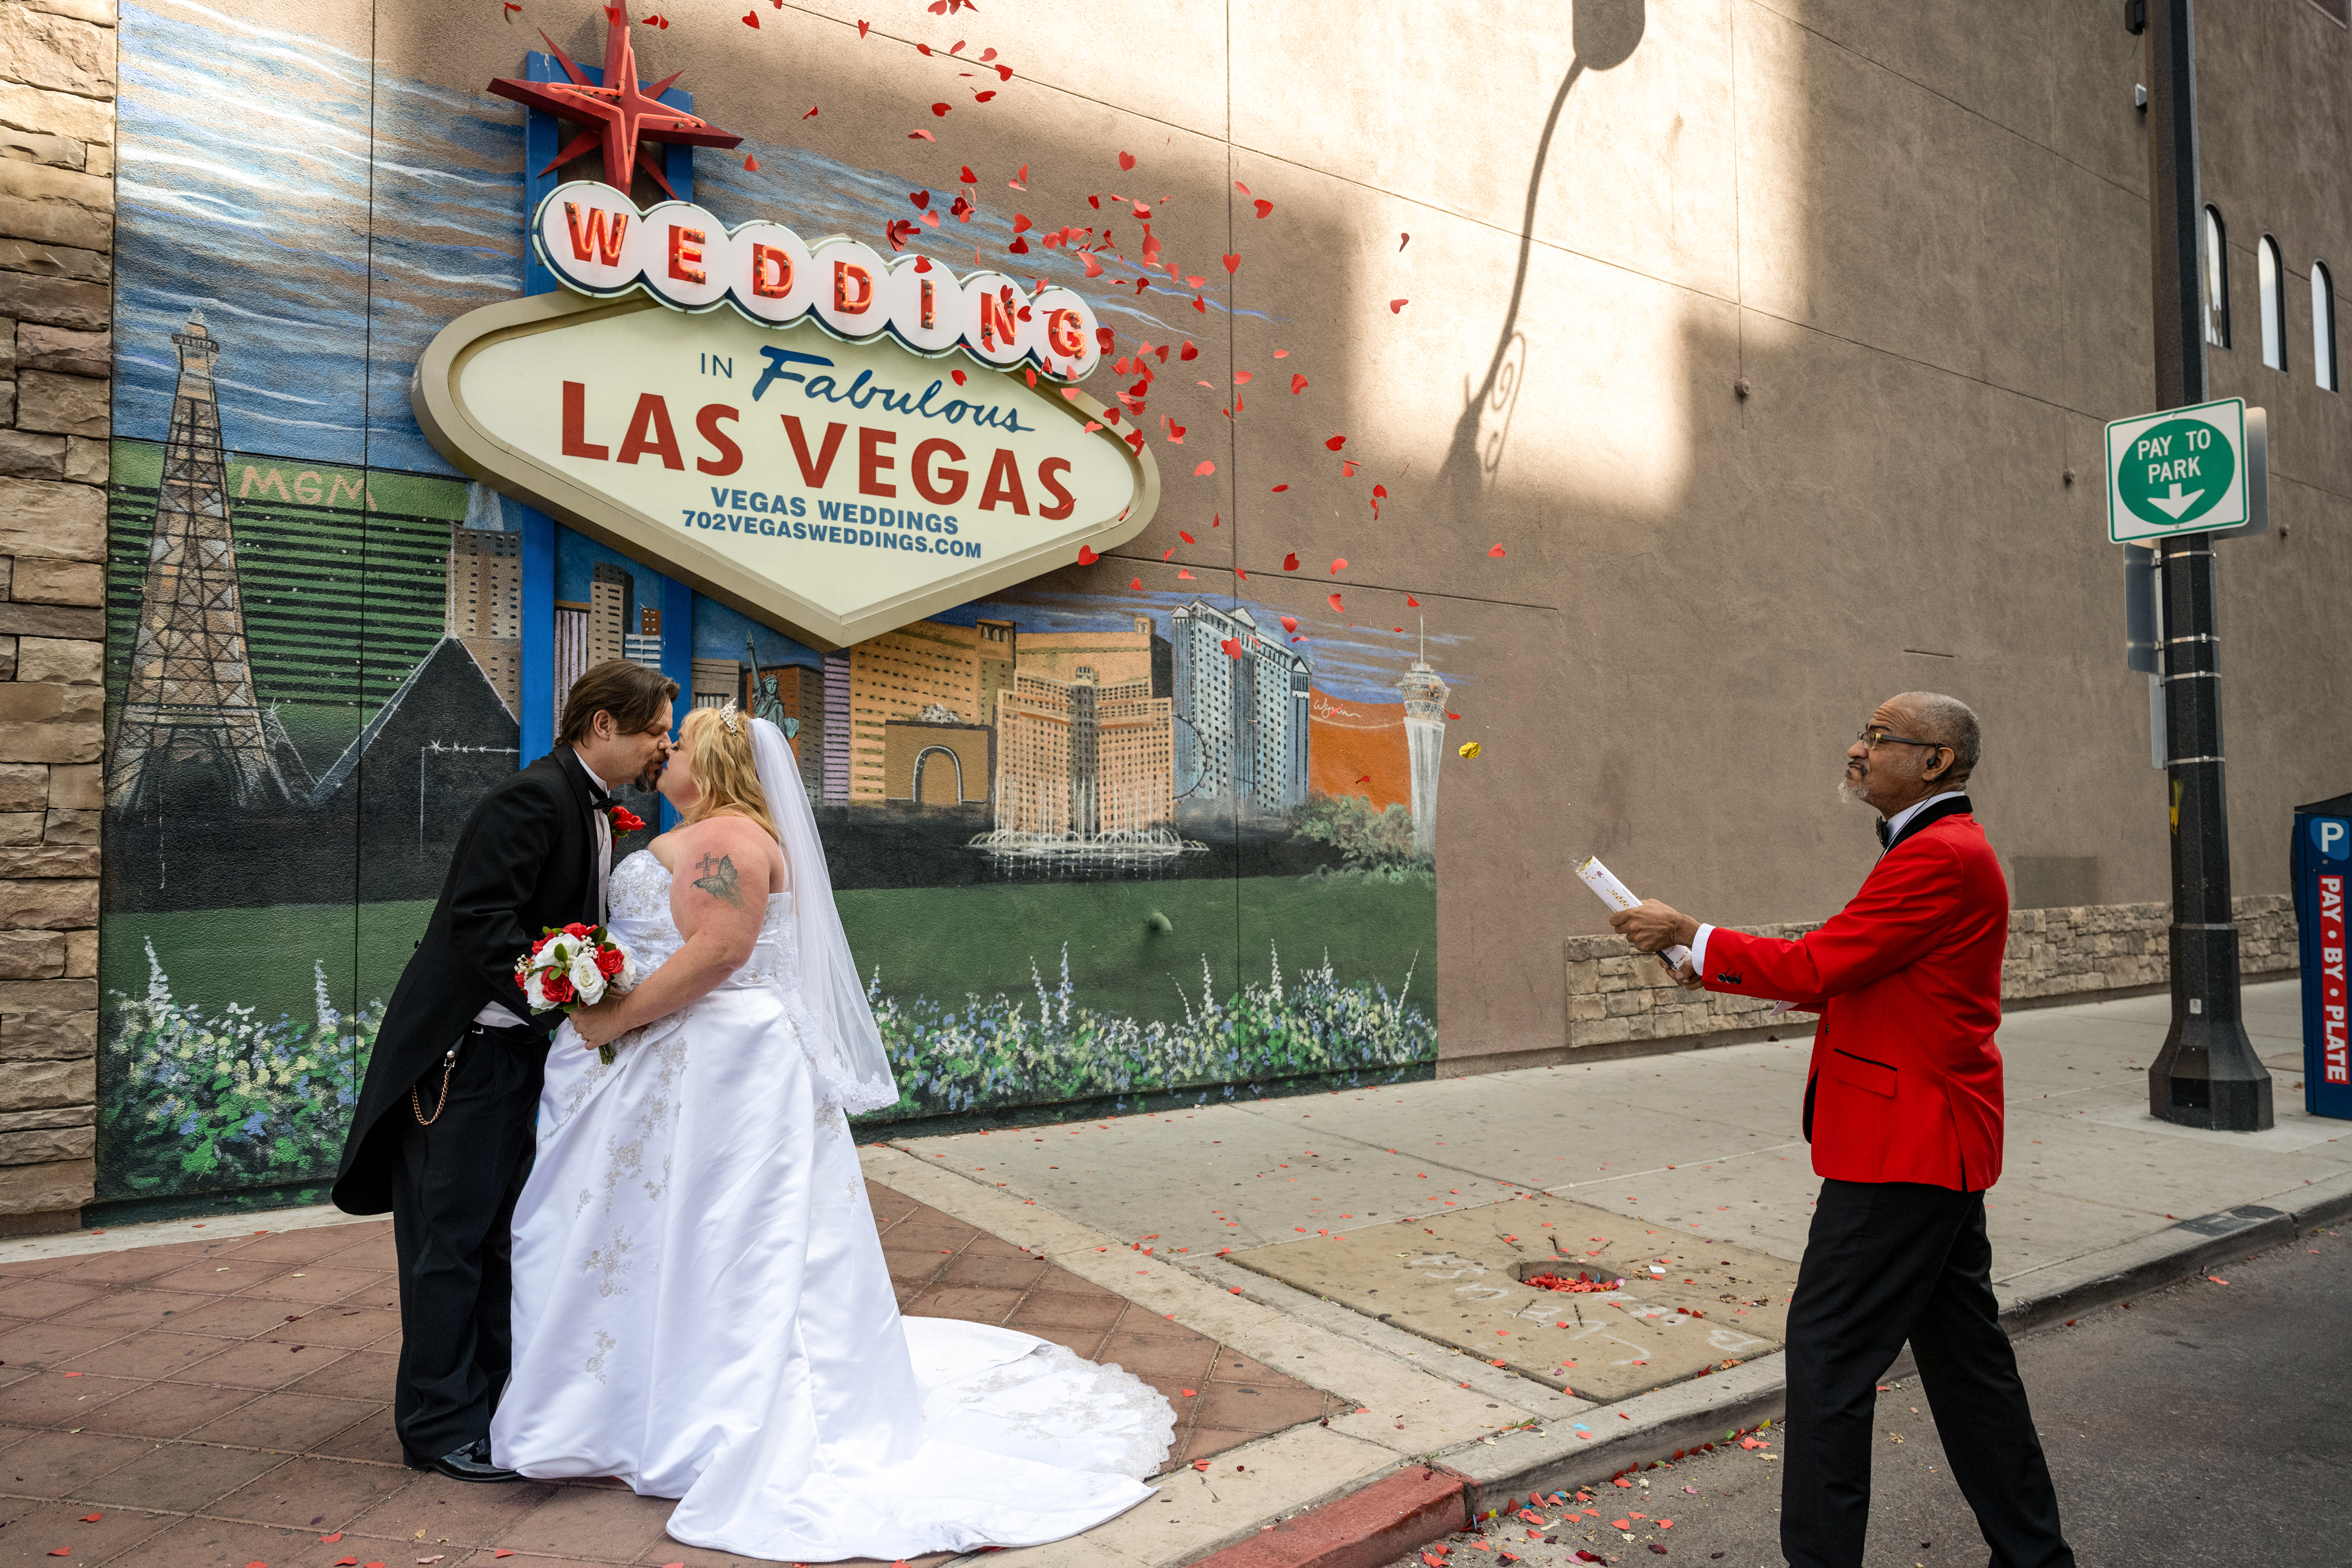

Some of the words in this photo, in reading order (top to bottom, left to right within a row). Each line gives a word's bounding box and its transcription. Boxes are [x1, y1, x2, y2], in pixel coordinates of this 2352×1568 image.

[563, 201, 1087, 359] WEDDING
[701, 353, 732, 379] IN
[752, 345, 1035, 433] Fabulous
[562, 380, 743, 476] LAS
[780, 413, 1075, 521] VEGAS
[2138, 435, 2172, 460] PAY
[2185, 429, 2211, 451] TO
[238, 466, 377, 511] MGM
[2148, 456, 2201, 484] PARK
[710, 486, 806, 517] VEGAS
[817, 500, 959, 535] WEDDINGS
[682, 510, 982, 558] 702VEGASWEDDINGS.COM
[2321, 822, 2344, 852] P
[1607, 887, 1629, 909] opper
[2322, 878, 2342, 924] PAY
[2324, 947, 2344, 981] BY
[2325, 1005, 2347, 1081] PLATE
